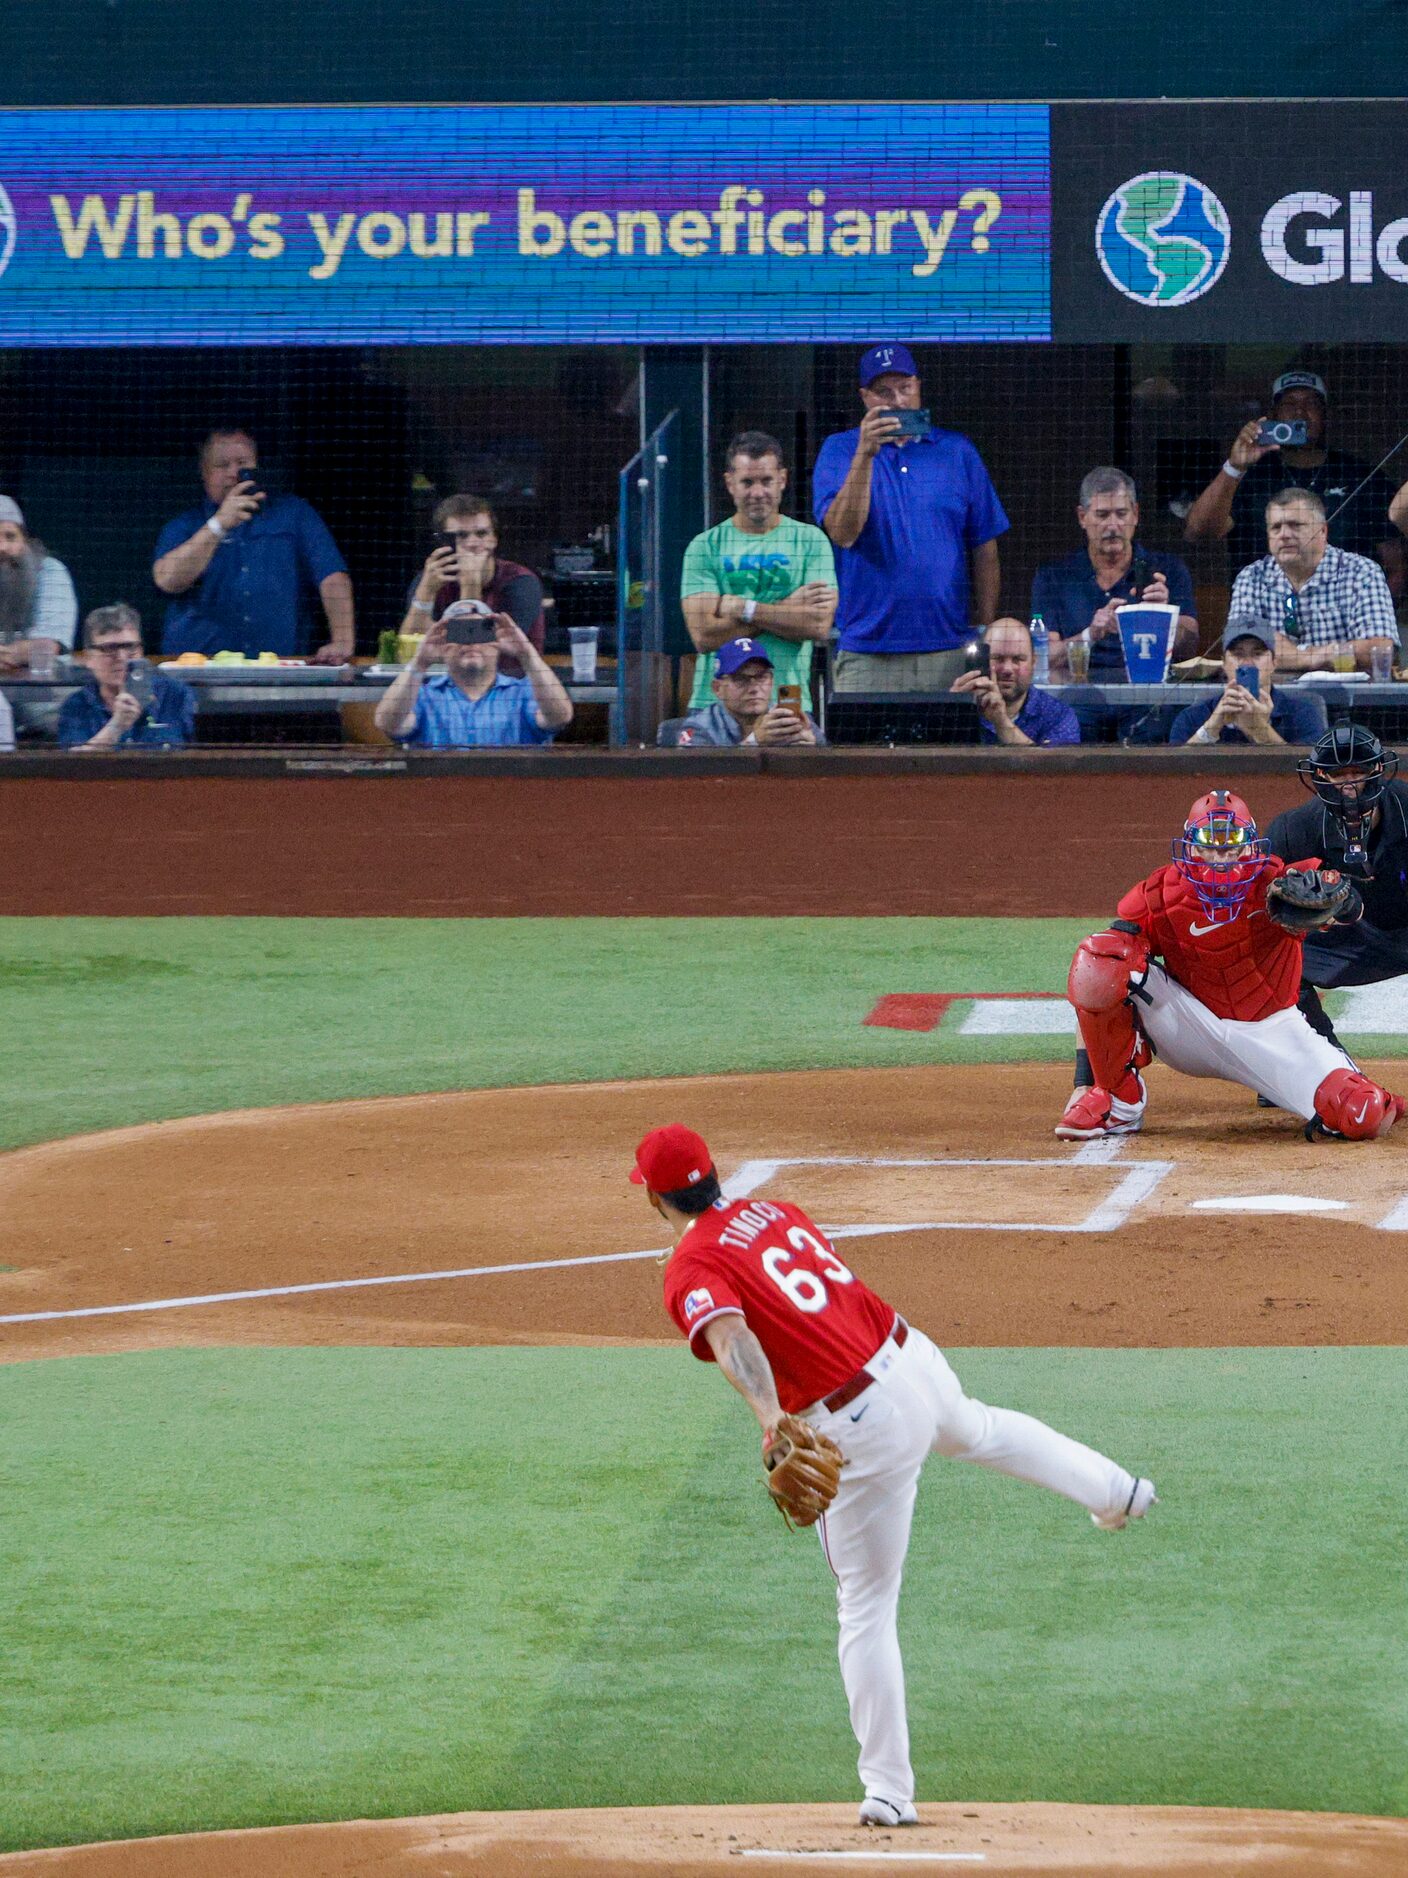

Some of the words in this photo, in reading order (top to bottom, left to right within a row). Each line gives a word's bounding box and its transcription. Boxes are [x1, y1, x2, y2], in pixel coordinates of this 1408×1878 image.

[51, 191, 284, 259] Who's
[309, 212, 490, 279] your
[518, 186, 1002, 276] beneficiary?
[734, 637, 753, 652] T
[1132, 633, 1158, 660] T
[761, 1225, 854, 1313] 63
